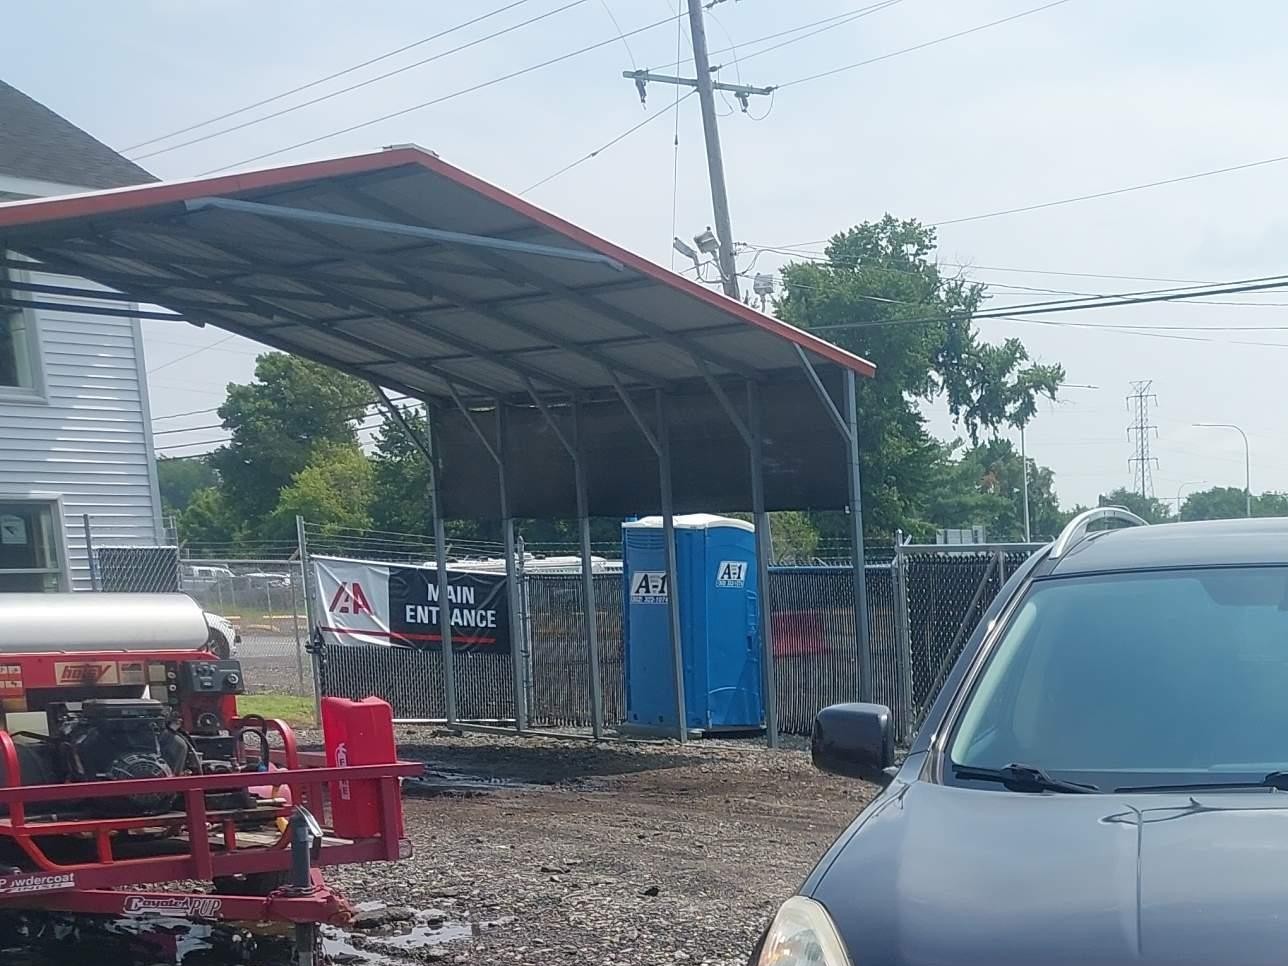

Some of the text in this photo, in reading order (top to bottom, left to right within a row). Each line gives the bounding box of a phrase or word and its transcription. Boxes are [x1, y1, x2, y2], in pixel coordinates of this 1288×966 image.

[720, 563, 743, 580] A-1
[427, 583, 475, 604] MAIN
[635, 573, 668, 594] A-1
[405, 604, 497, 628] ENTANCE
